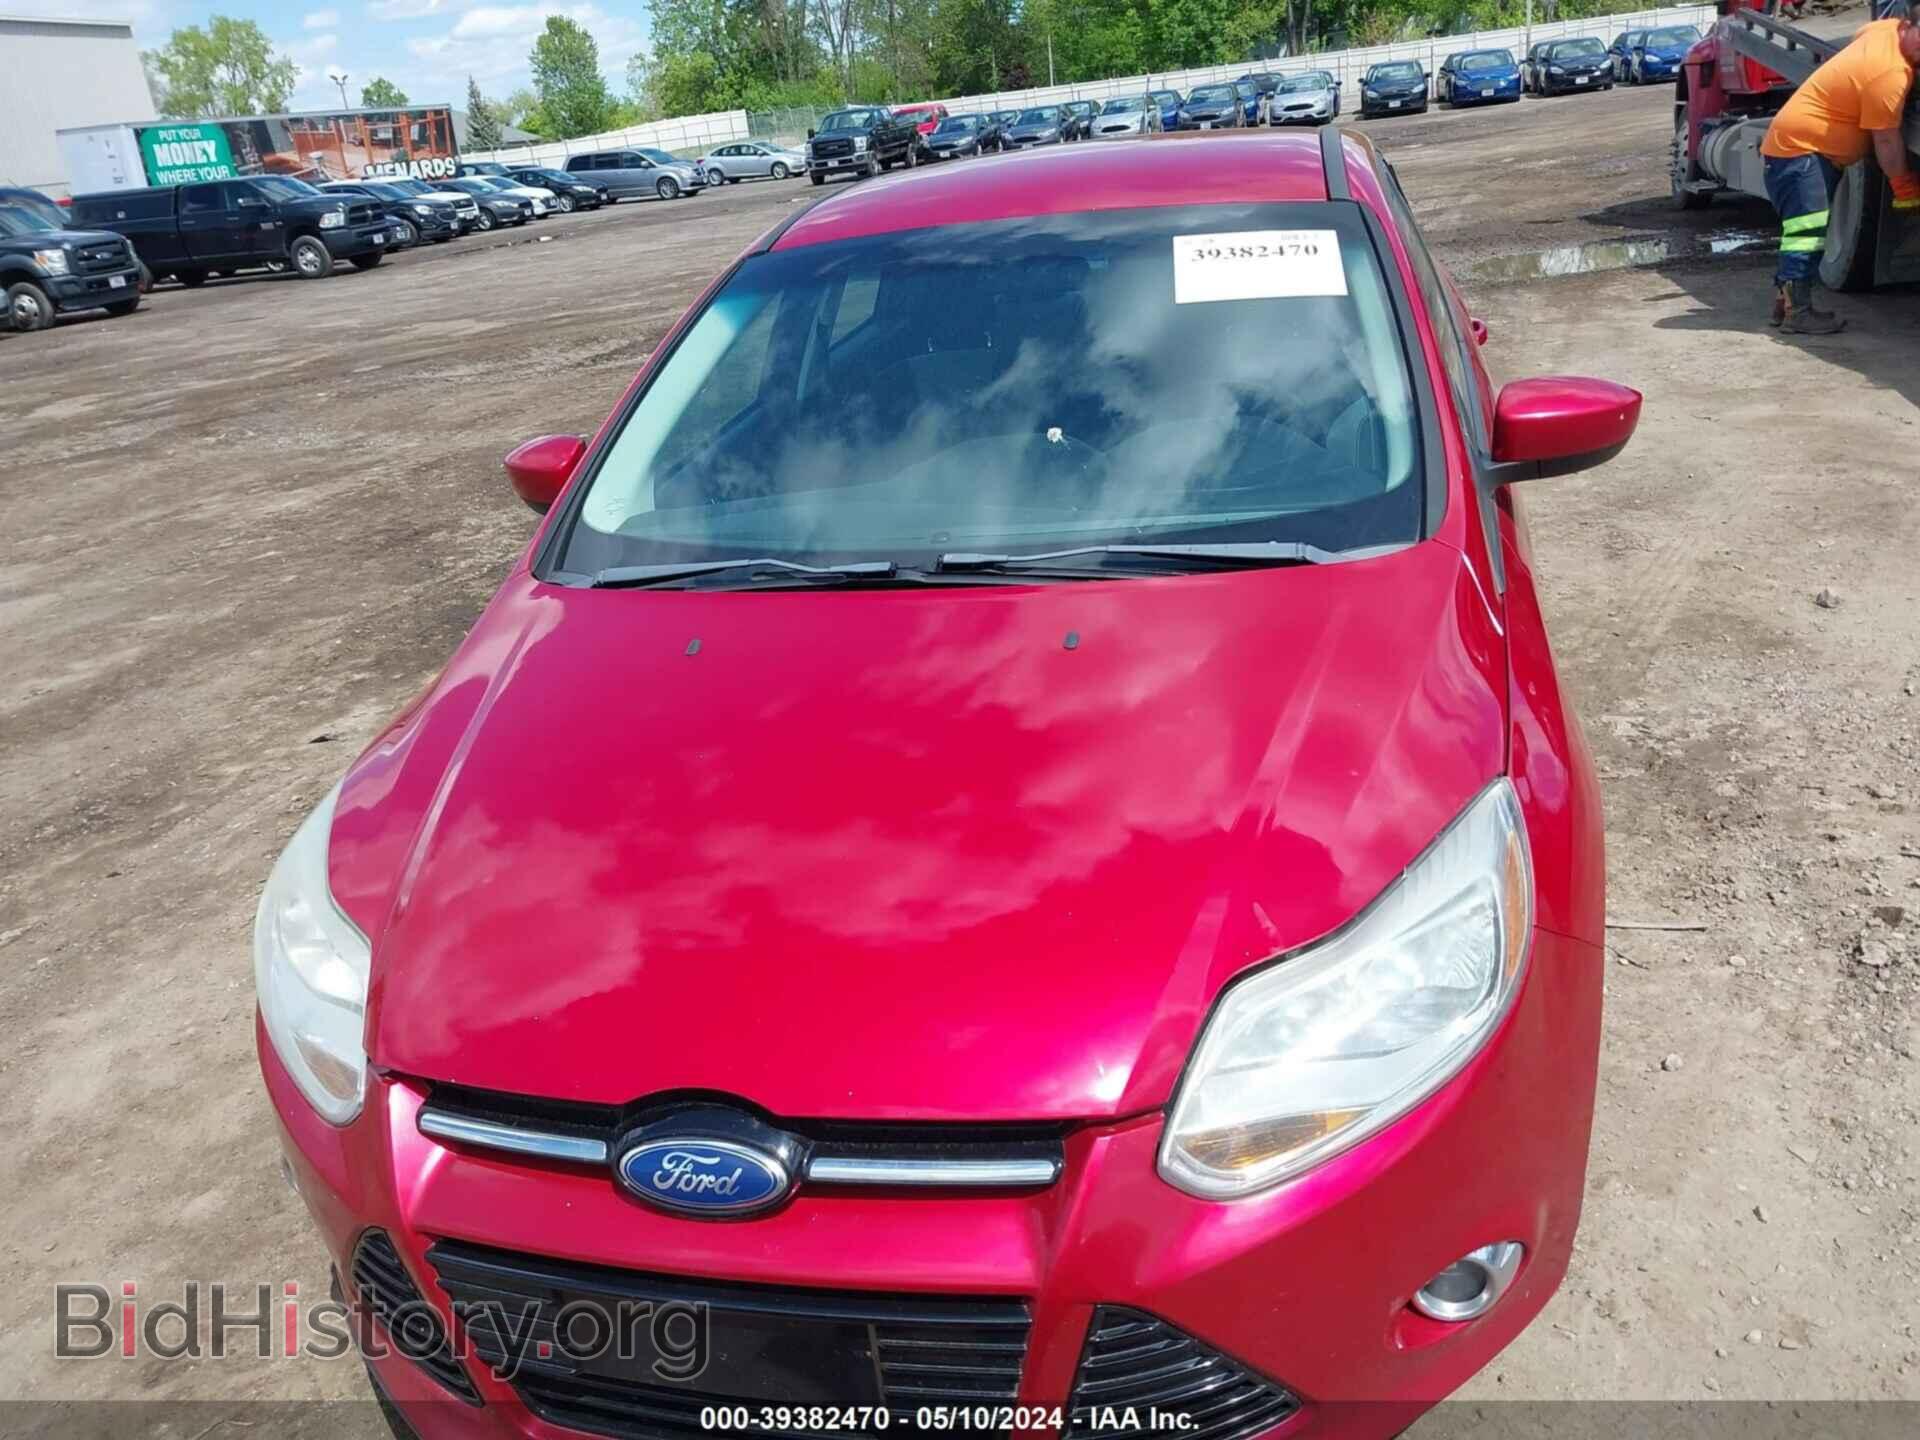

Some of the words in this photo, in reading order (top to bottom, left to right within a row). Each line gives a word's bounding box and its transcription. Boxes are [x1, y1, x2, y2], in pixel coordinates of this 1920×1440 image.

[158, 129, 178, 142] PUT
[177, 127, 203, 140] YOUR
[153, 139, 217, 167] MONEY
[156, 168, 199, 184] WHERE
[198, 164, 231, 181] YOUR
[363, 156, 457, 180] MENARDS
[1191, 244, 1319, 263] 39382470
[652, 1151, 743, 1196] Ford
